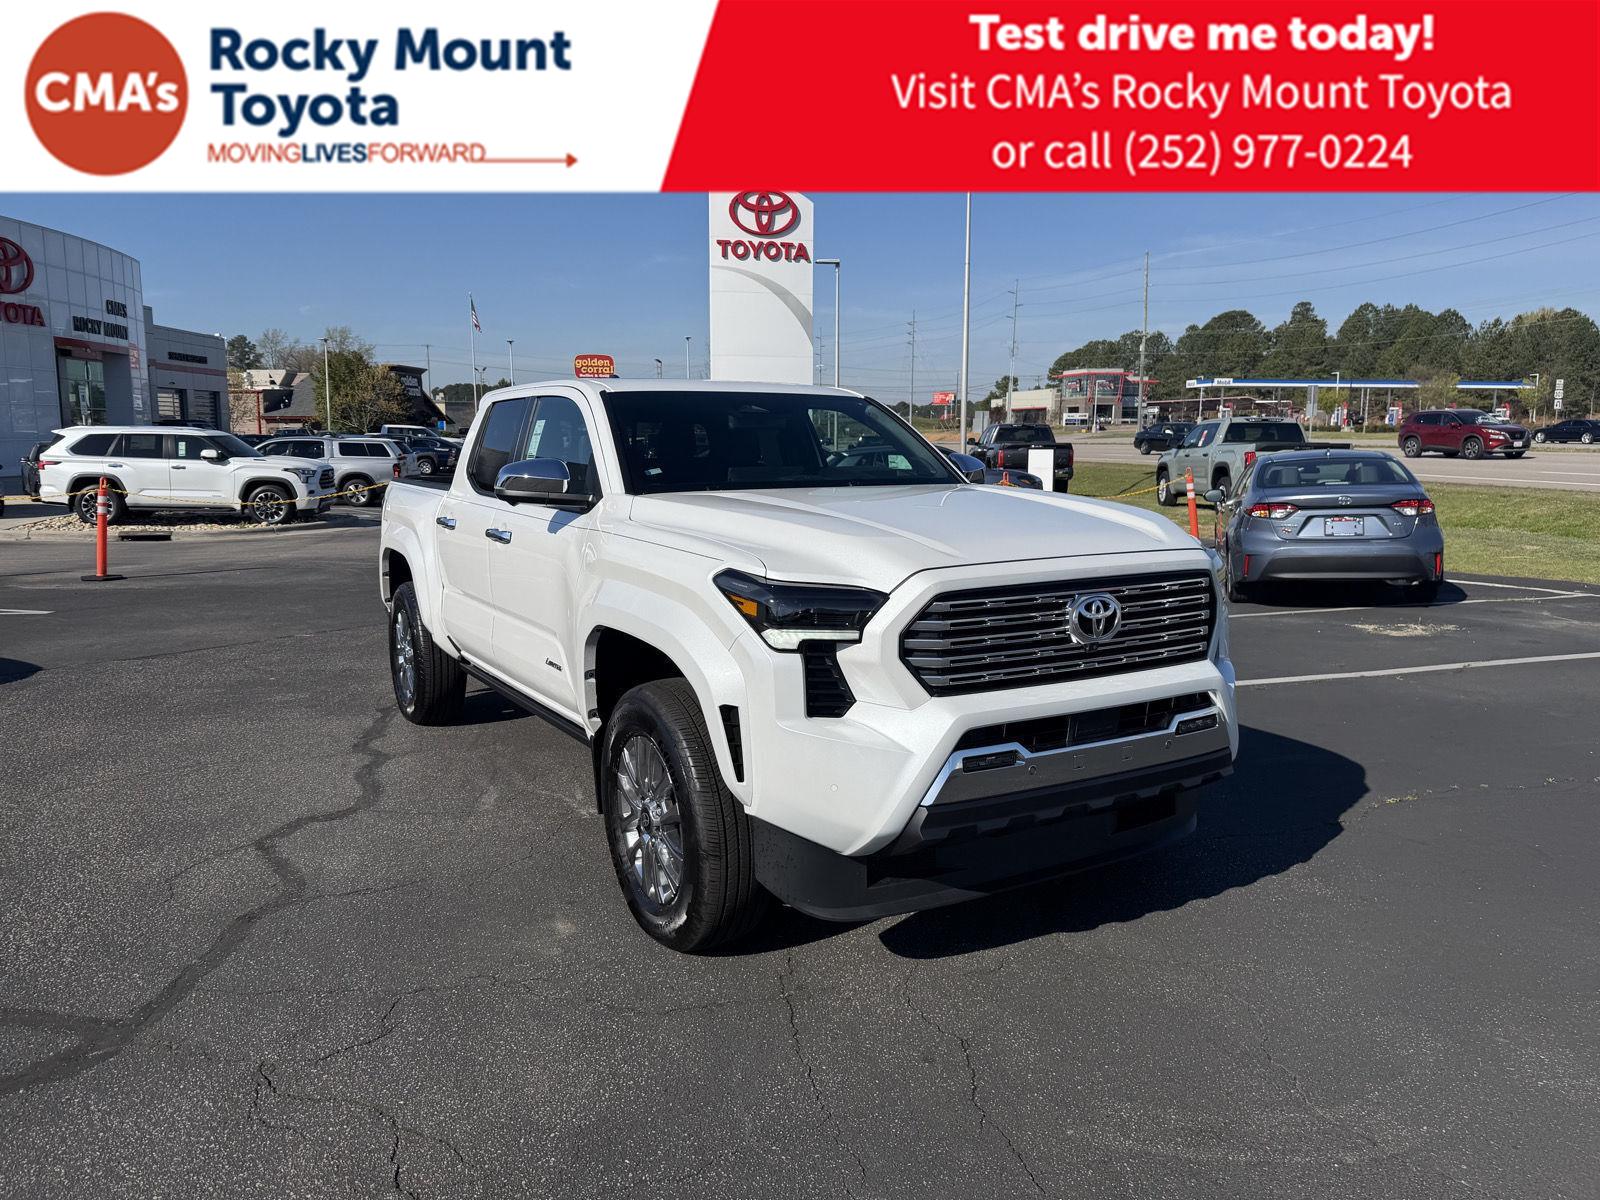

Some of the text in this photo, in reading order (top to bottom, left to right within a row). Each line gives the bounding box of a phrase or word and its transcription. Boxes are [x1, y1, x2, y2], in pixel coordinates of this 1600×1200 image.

[717, 239, 812, 263] TOYOTA
[72, 315, 129, 340] ROCKY MOUNT
[575, 358, 611, 369] golden
[581, 365, 615, 374] corral
